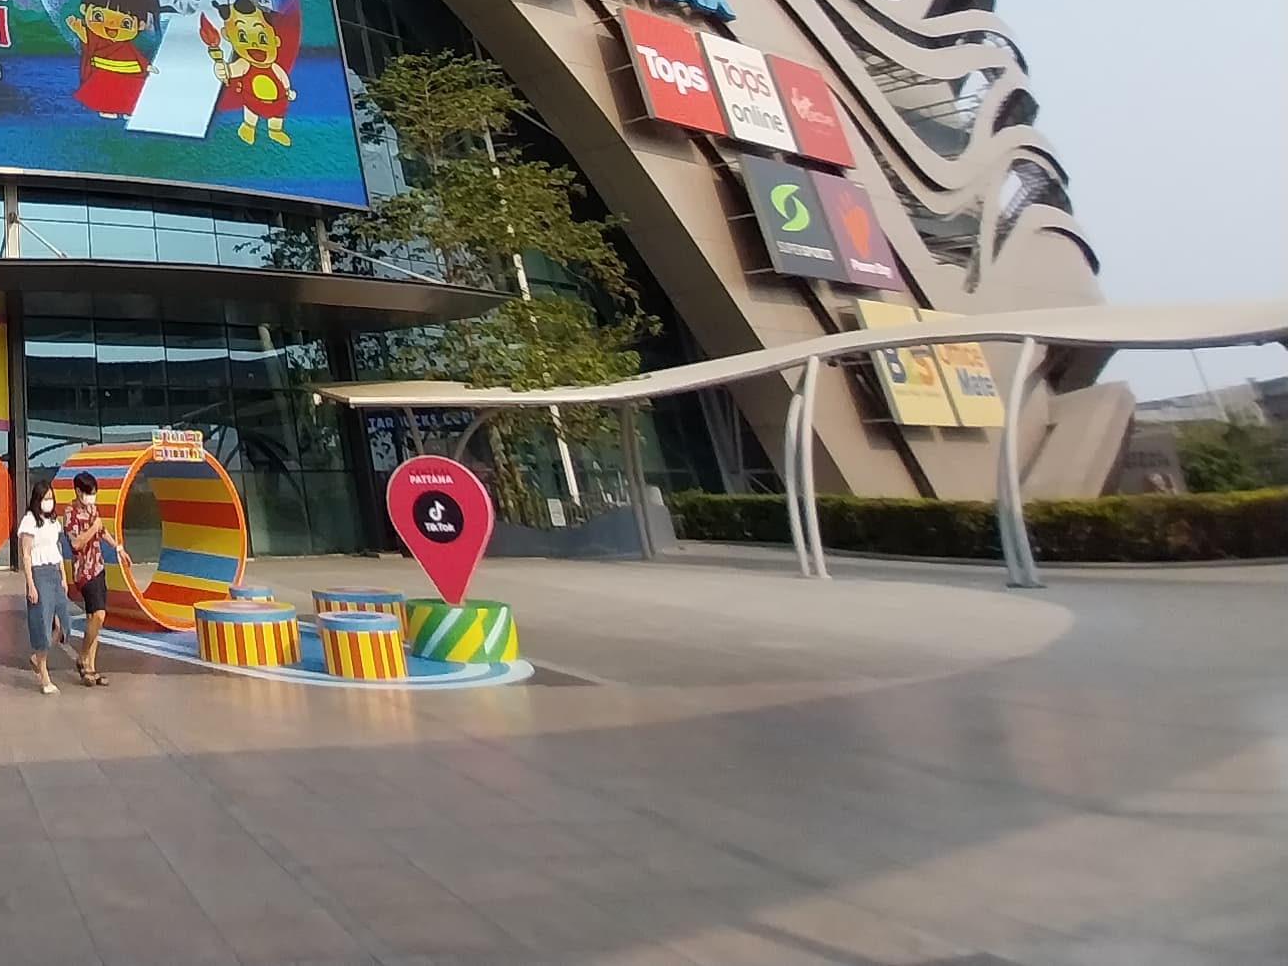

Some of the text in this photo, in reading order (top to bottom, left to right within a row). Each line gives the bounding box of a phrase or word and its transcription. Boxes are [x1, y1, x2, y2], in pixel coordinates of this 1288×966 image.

[635, 44, 710, 96] Tops
[714, 55, 771, 101] Tops
[730, 103, 785, 134] online
[409, 475, 454, 485] PATTANA
